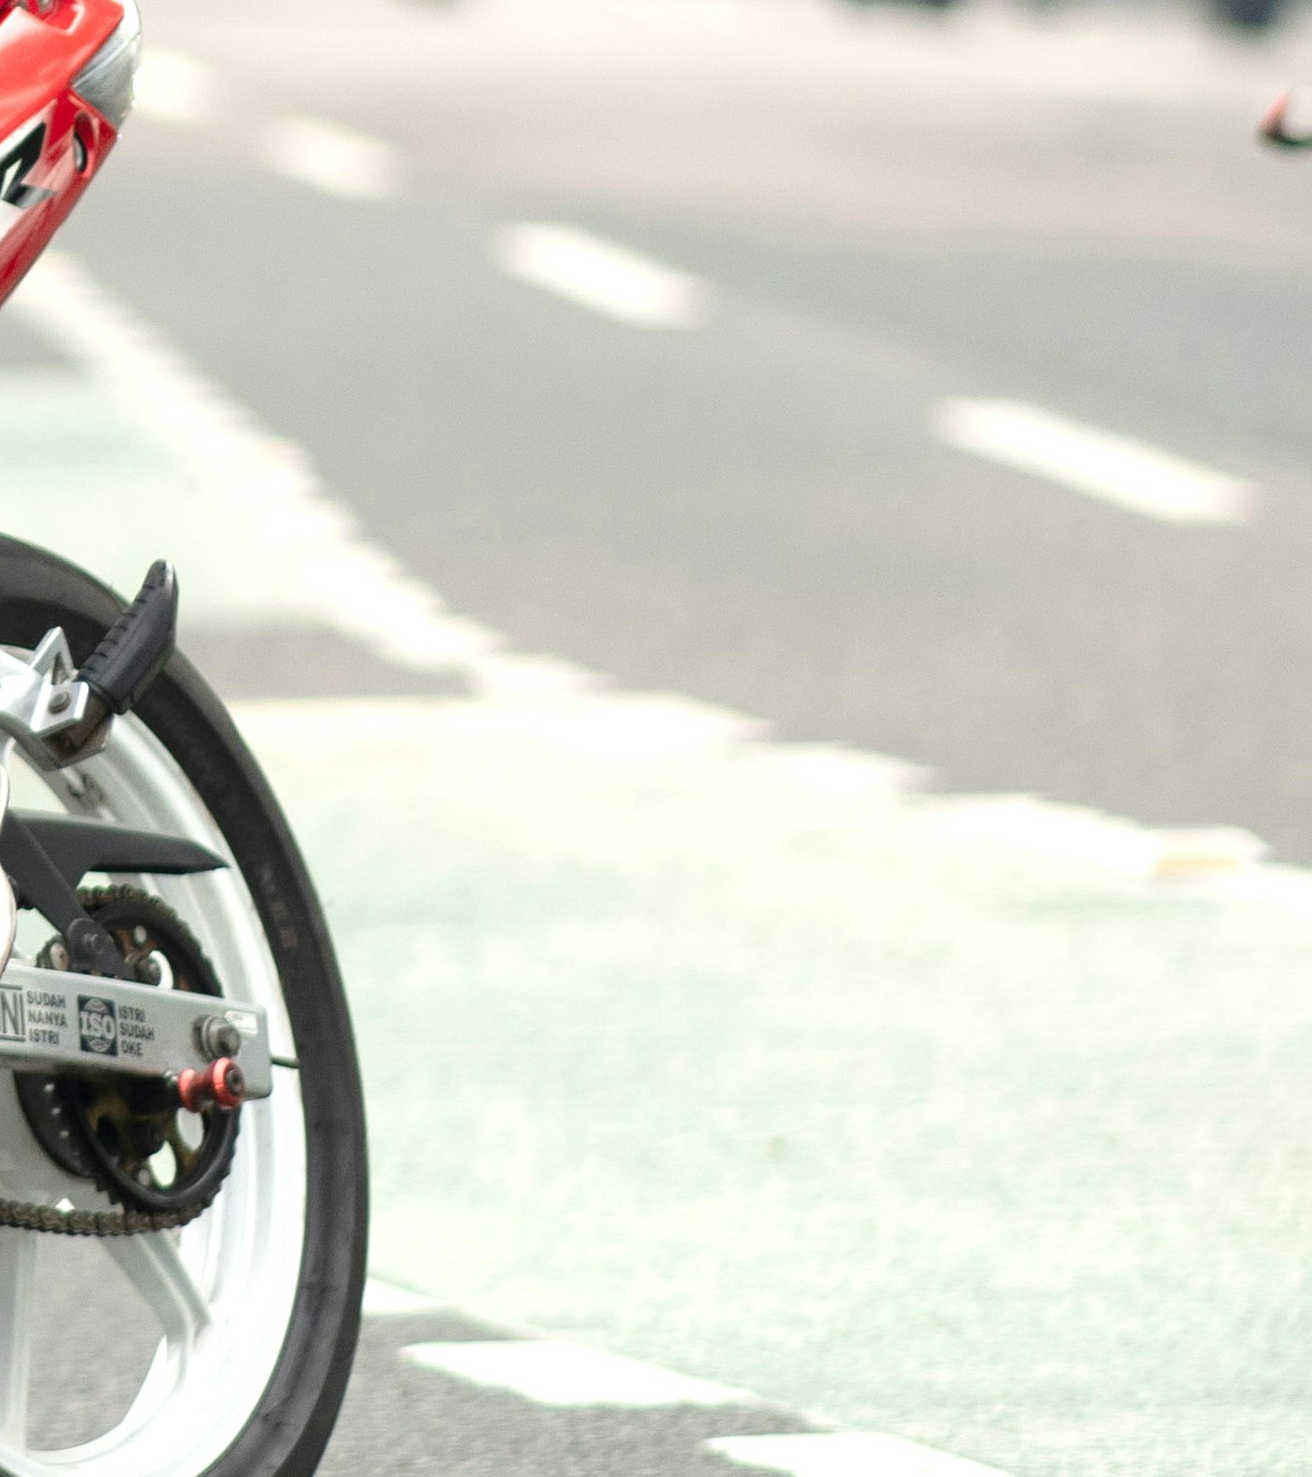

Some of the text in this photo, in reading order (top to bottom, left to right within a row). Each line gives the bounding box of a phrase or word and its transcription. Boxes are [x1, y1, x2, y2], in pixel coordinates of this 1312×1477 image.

[26, 990, 67, 1009] SUDAH
[27, 1009, 69, 1028] NANYA
[117, 1004, 147, 1024] ISTRI
[79, 1010, 116, 1041] ISO
[118, 1021, 156, 1042] SUDAH
[28, 1026, 61, 1046] ISTRI
